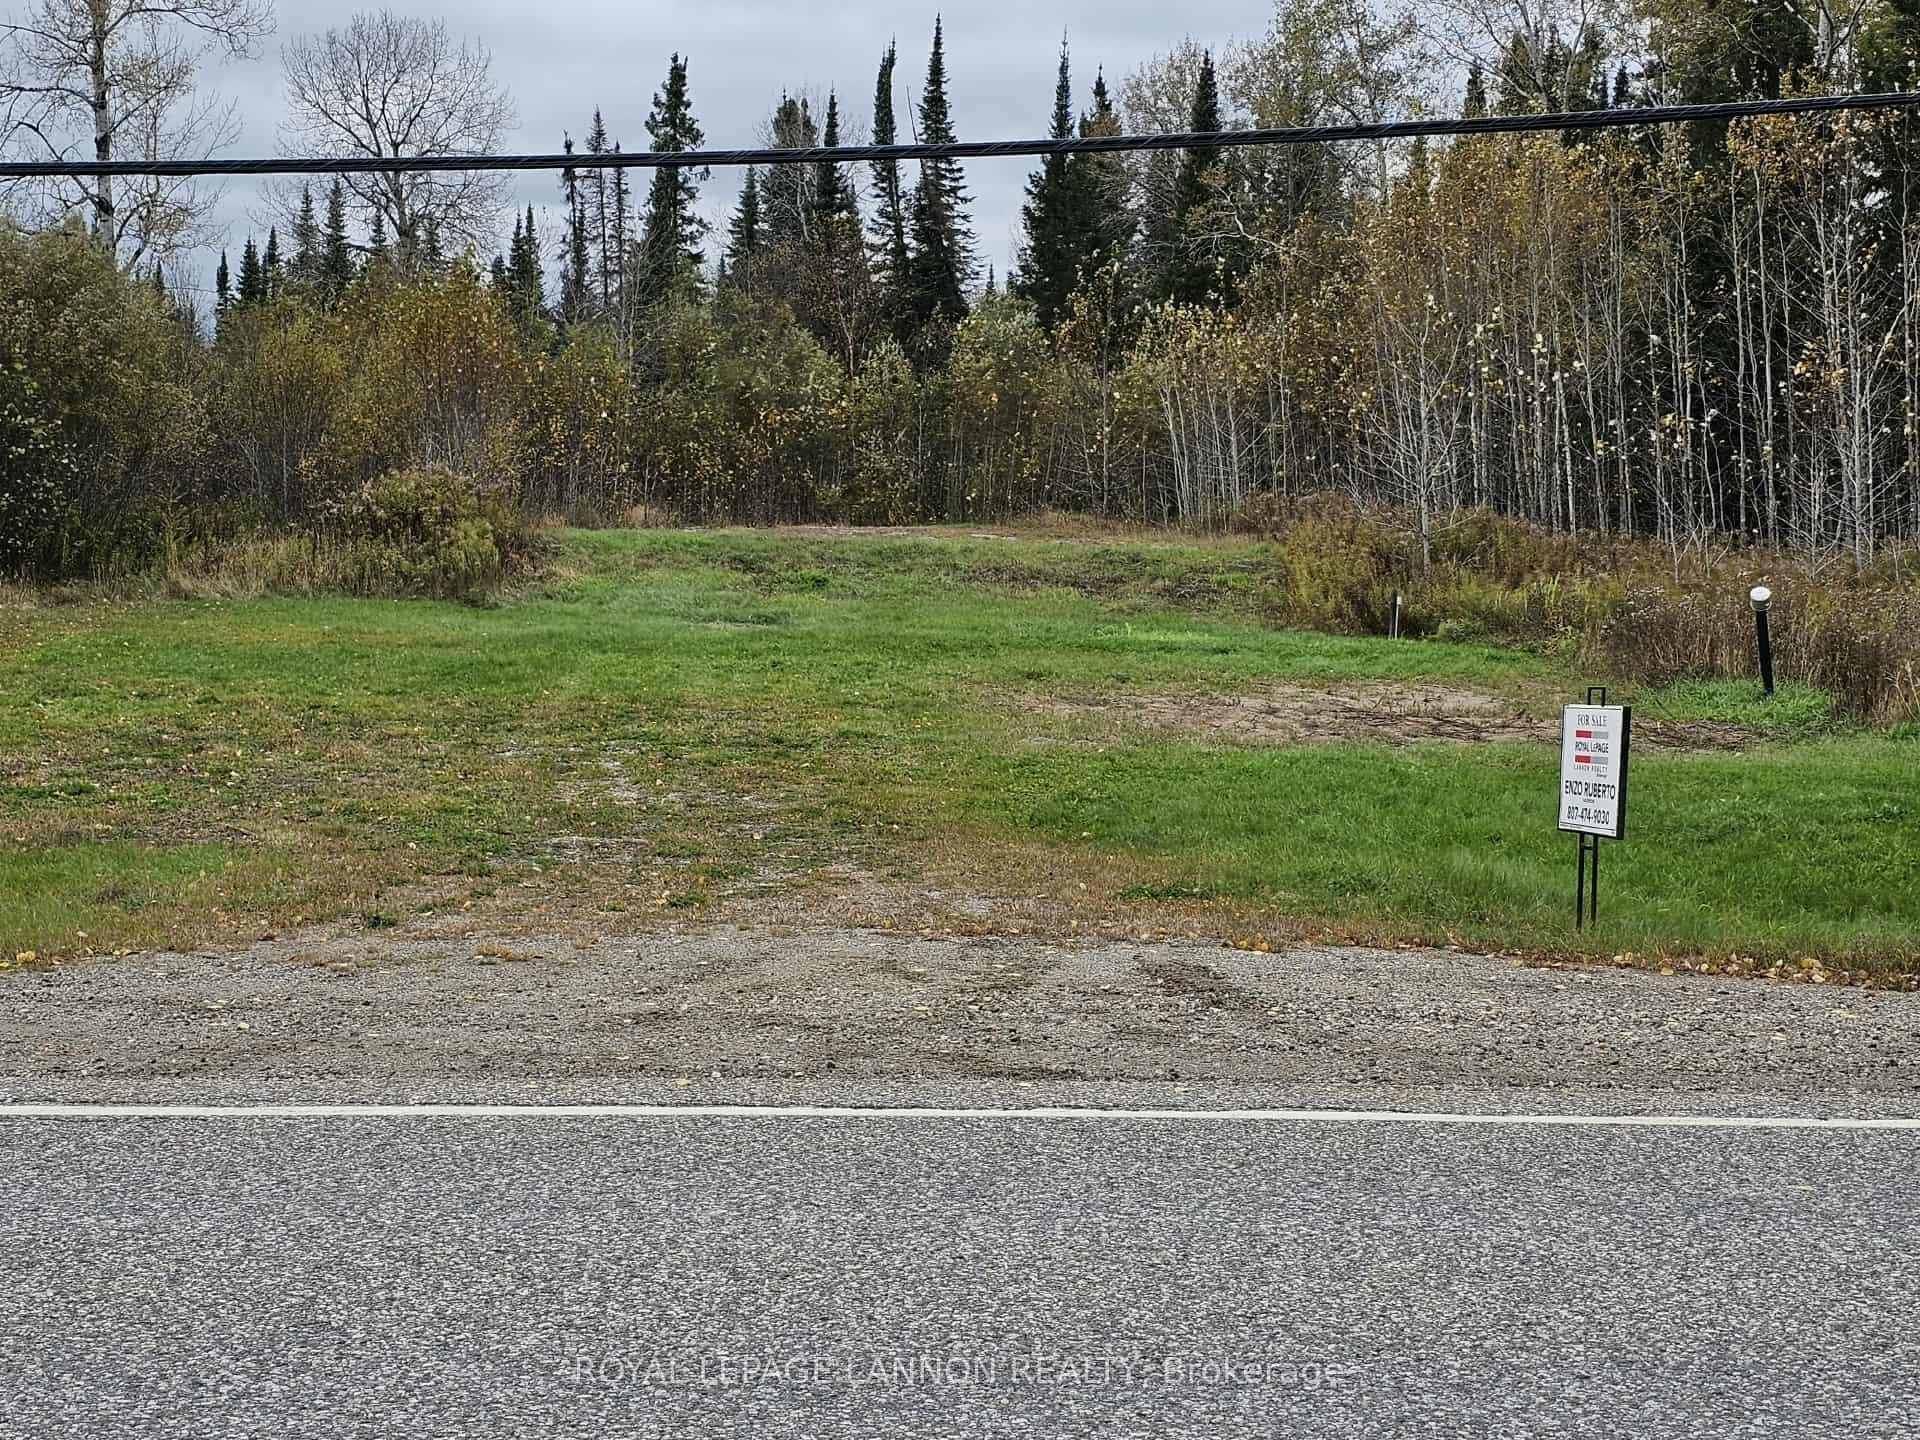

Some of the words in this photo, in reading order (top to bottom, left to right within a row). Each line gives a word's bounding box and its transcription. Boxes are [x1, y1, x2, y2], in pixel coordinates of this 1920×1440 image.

[1577, 714, 1590, 726] FOR
[1591, 714, 1607, 727] SALE
[1575, 741, 1590, 752] ROYAL
[1565, 780, 1583, 796] ENZO
[1584, 782, 1616, 800] RUBERTO
[1567, 805, 1610, 825] 807-474-9030
